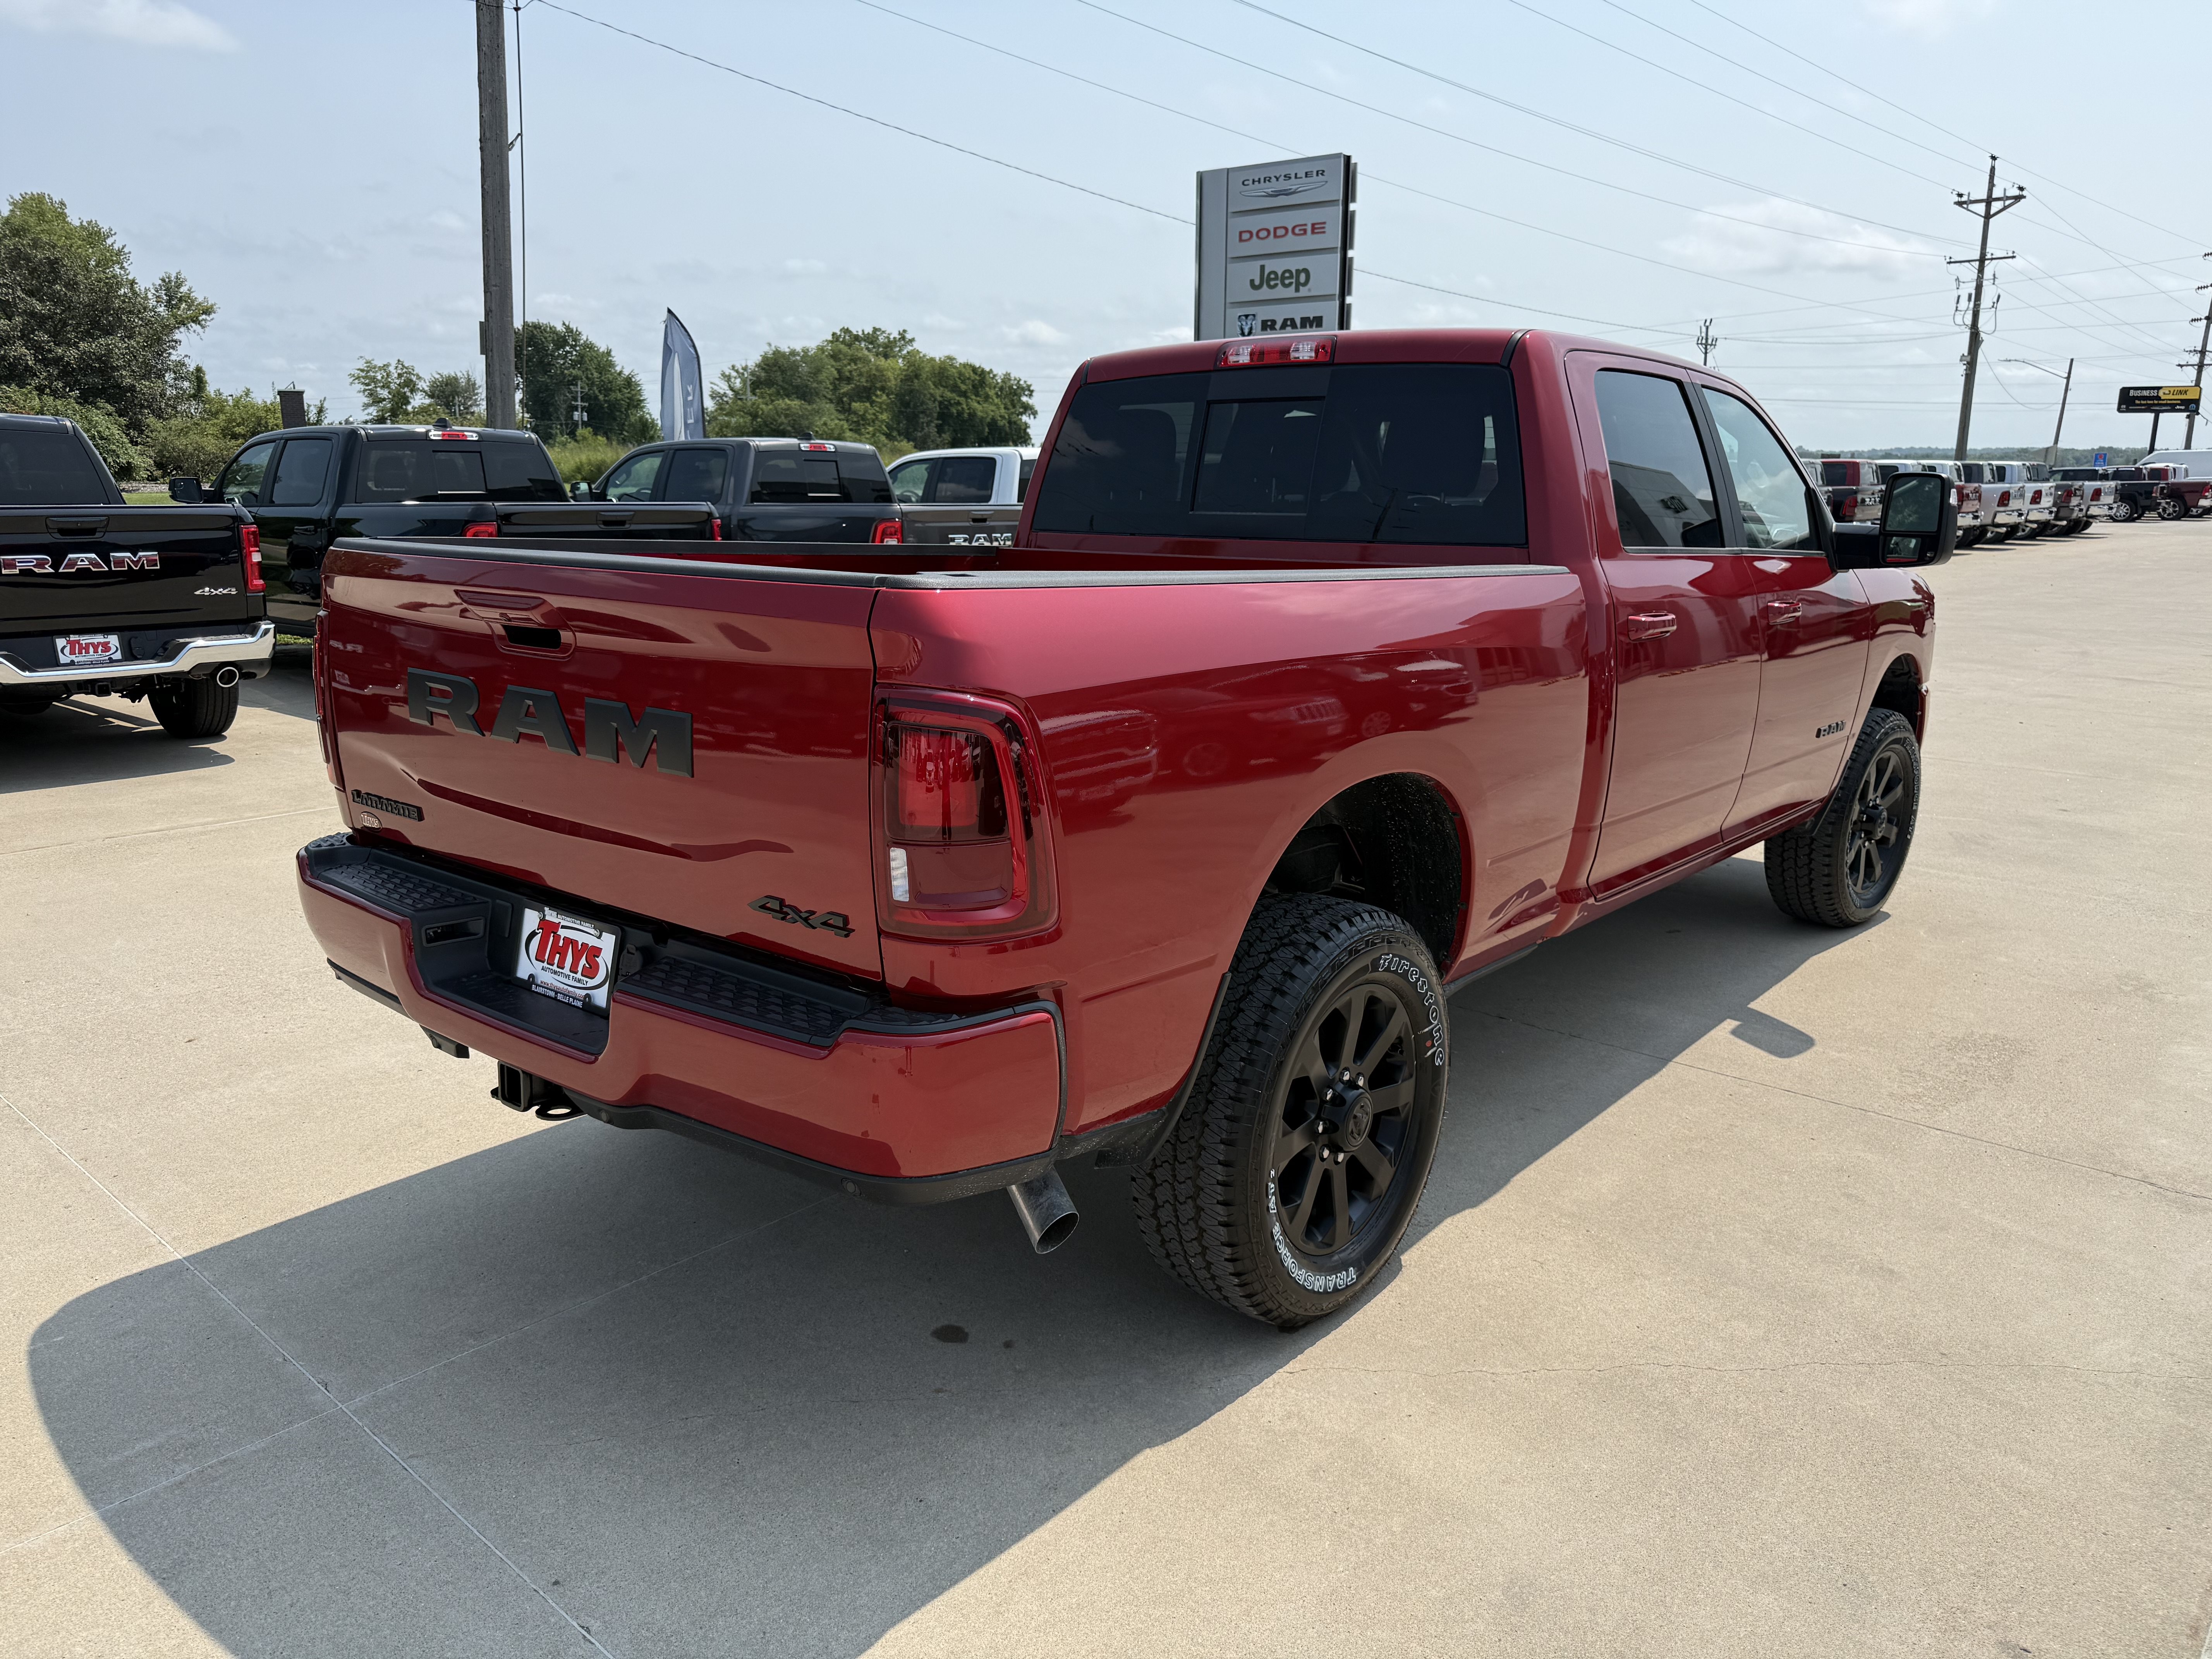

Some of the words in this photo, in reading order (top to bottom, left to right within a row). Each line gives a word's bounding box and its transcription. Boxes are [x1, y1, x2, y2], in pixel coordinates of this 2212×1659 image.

[1242, 169, 1326, 186] CHRYSLER
[1239, 221, 1327, 243] DODGE
[1249, 264, 1310, 293] Jeep
[1261, 315, 1323, 332] RAM
[948, 533, 1012, 545] RAM
[0, 551, 160, 574] RAM
[193, 587, 239, 596] 4x4
[66, 639, 112, 656] THYS
[407, 667, 695, 778] RAM
[1815, 720, 1846, 738] RAM
[351, 789, 424, 822] LARAMIE
[361, 812, 380, 828] THYS
[557, 914, 580, 925] AUTOMOTIVE
[581, 921, 594, 929] FAMILY
[747, 895, 856, 938] 4x4
[535, 919, 603, 980] THYS
[541, 965, 571, 981] AUTOMOTIVE
[572, 975, 589, 986] FAMILY
[532, 984, 555, 998] BLAIRSTOWN
[557, 993, 569, 1003] BELLE
[569, 997, 583, 1008] PLAINE
[1379, 954, 1444, 1066] Firestone
[1273, 1221, 1356, 1292] TRANSFORCE
